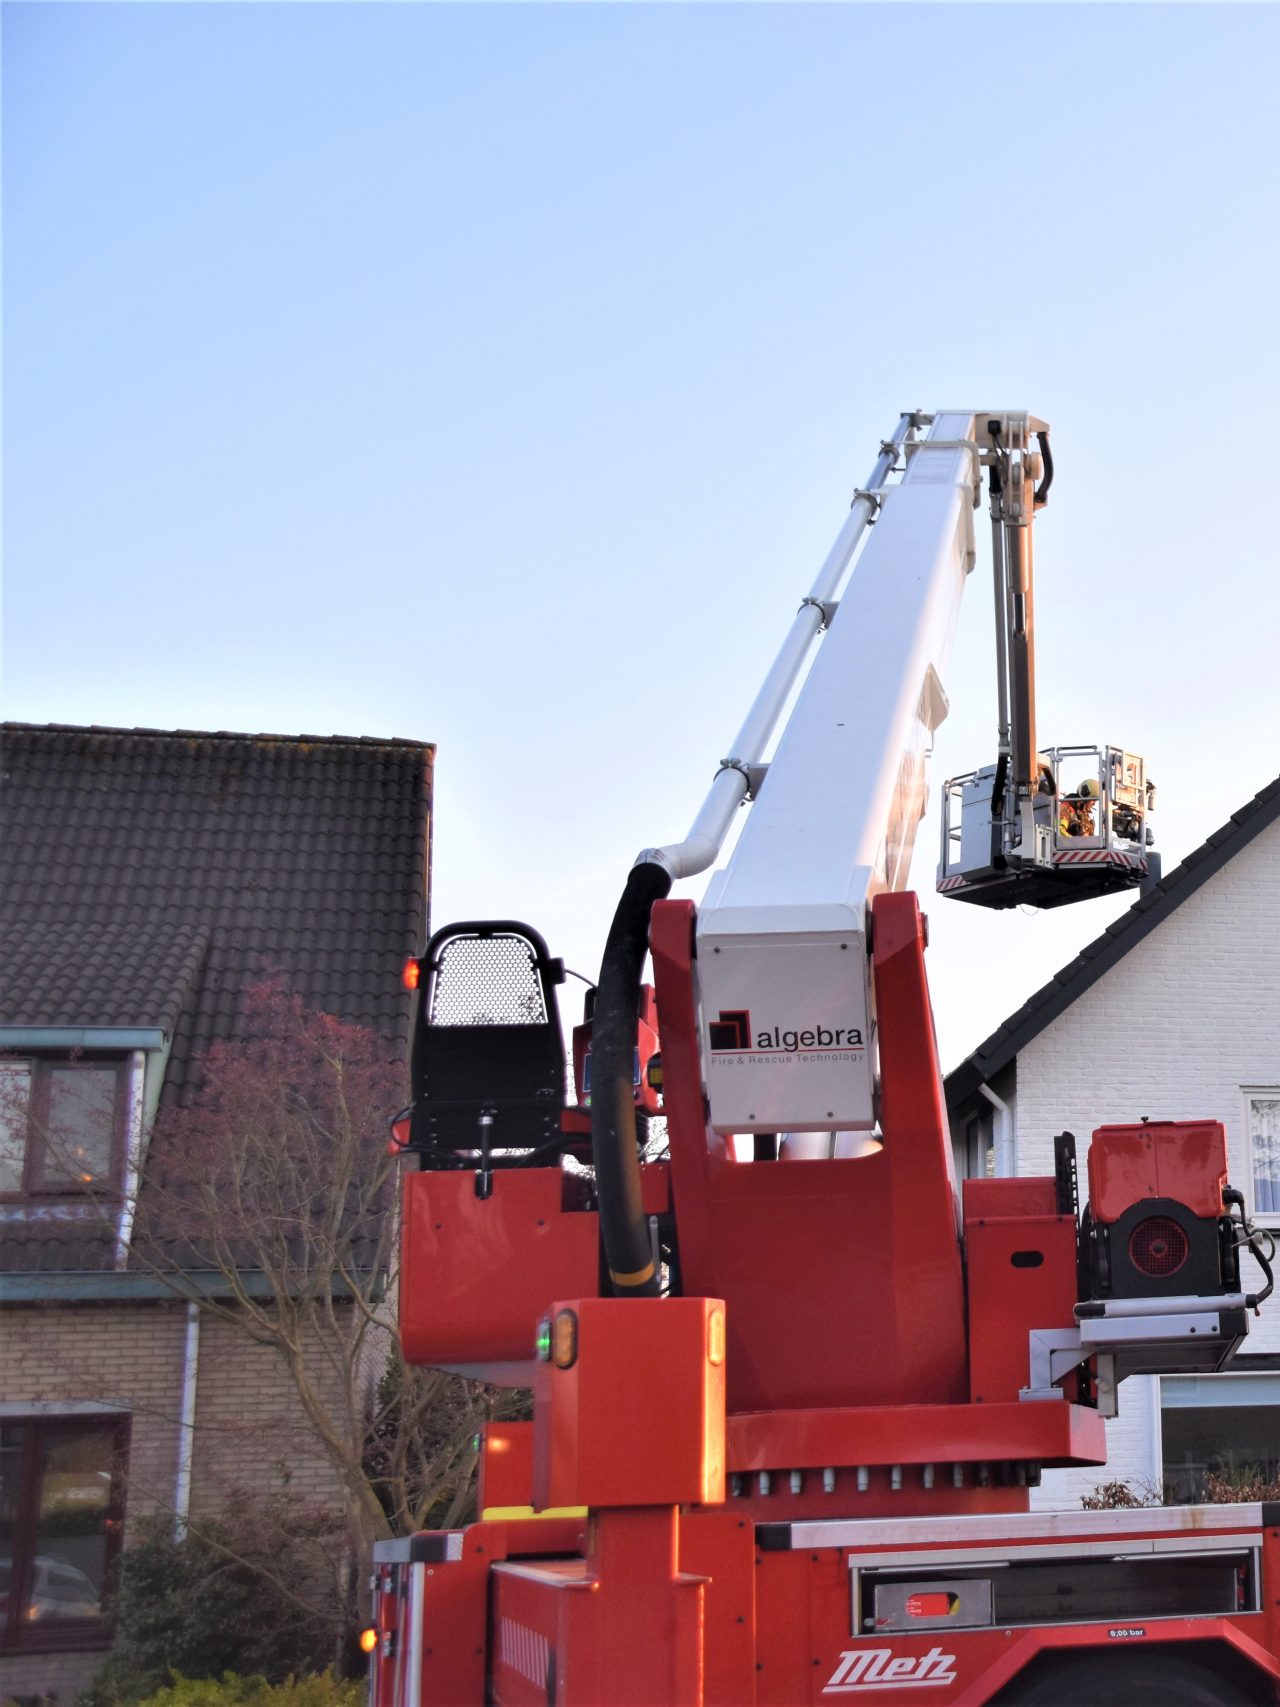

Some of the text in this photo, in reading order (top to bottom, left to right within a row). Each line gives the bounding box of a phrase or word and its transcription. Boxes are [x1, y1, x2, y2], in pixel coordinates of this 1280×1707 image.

[757, 1025, 864, 1053] algebra
[711, 1053, 864, 1065] Fire & Rescue Technology
[1129, 1628, 1144, 1636] bar
[822, 1647, 957, 1692] Metz
